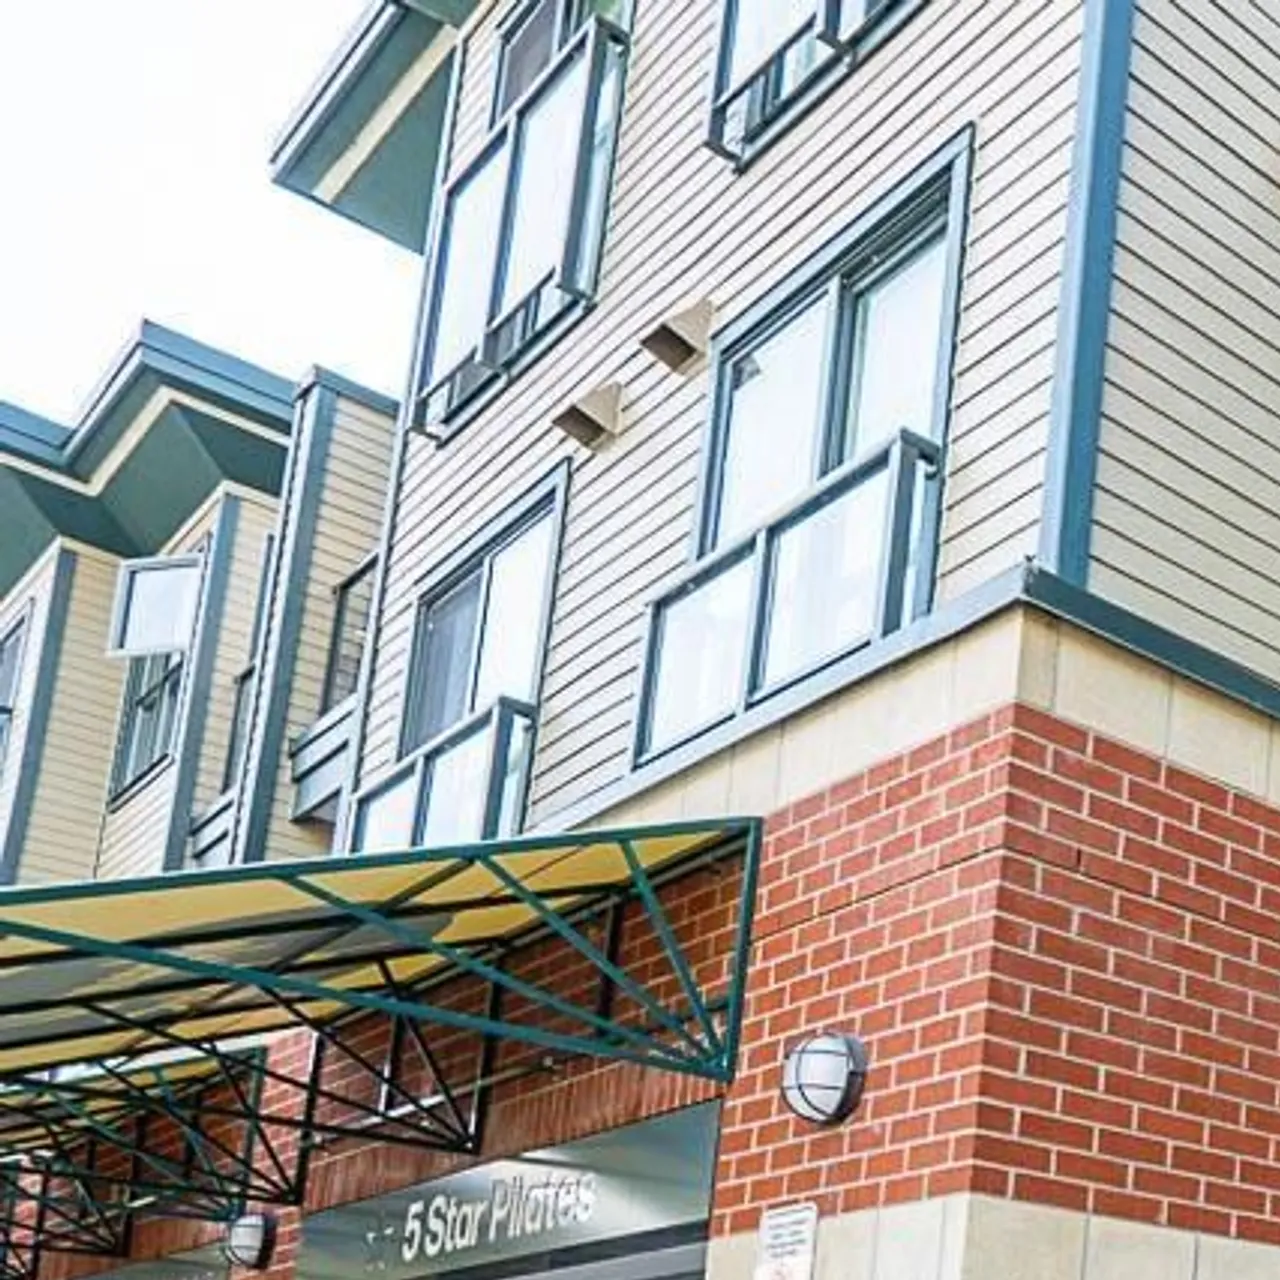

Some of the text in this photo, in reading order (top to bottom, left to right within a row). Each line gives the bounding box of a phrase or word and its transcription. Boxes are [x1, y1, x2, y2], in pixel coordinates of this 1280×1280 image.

[402, 1171, 599, 1262] 5 Star Pilates
